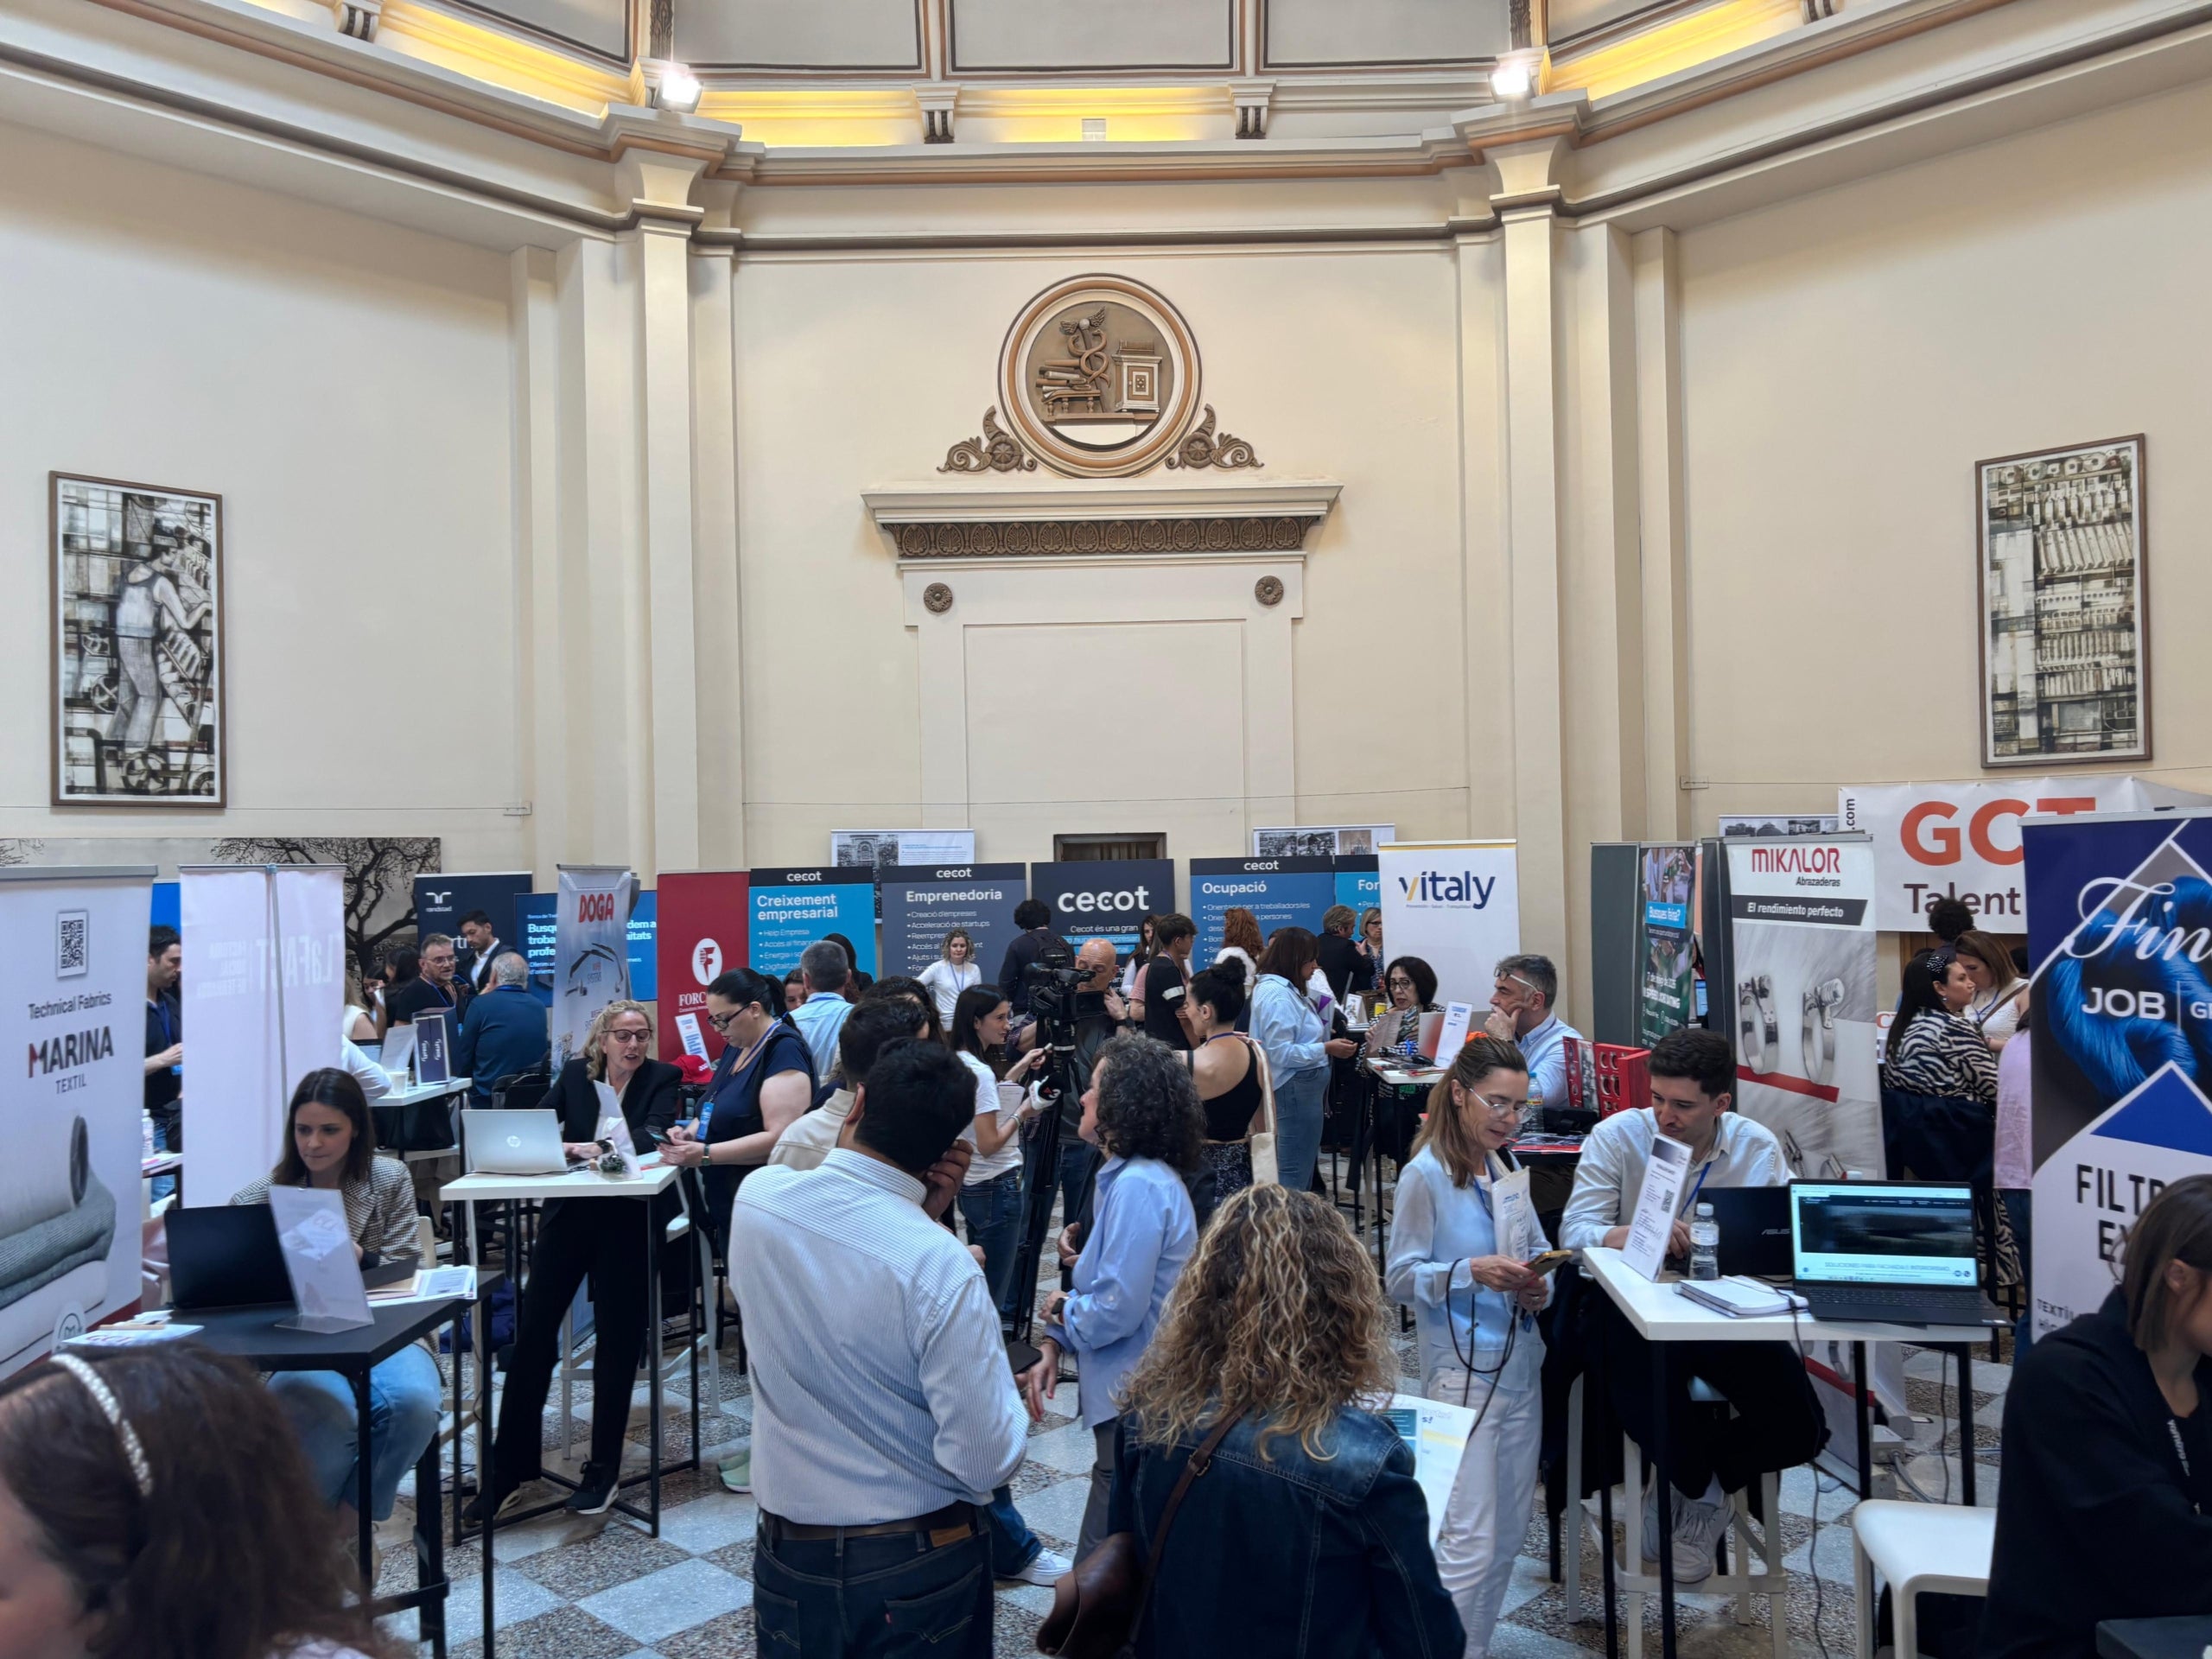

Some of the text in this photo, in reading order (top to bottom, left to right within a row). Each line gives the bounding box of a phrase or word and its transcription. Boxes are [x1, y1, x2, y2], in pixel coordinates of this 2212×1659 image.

[1901, 798, 2095, 867] GC
[1243, 860, 1280, 871] cecot
[1751, 848, 1841, 874] MIKALOR
[786, 871, 823, 882] cecot
[936, 867, 973, 879] cecot
[1796, 876, 1841, 887] Abrazaderas
[1202, 879, 1268, 896] Ocupació
[757, 893, 836, 907] Creixement
[906, 888, 1002, 905] Emprenedoria
[1057, 886, 1150, 913] cecot
[578, 893, 615, 924] DOGA
[758, 906, 838, 923] empresarial
[1747, 902, 1844, 918] El rendimiento perfecto
[1121, 925, 1139, 934] gran
[28, 990, 111, 1020] Technical Fabrics
[2082, 987, 2166, 1020] JOB
[29, 1026, 114, 1079] MARINA
[55, 1073, 87, 1095] TEXTIL
